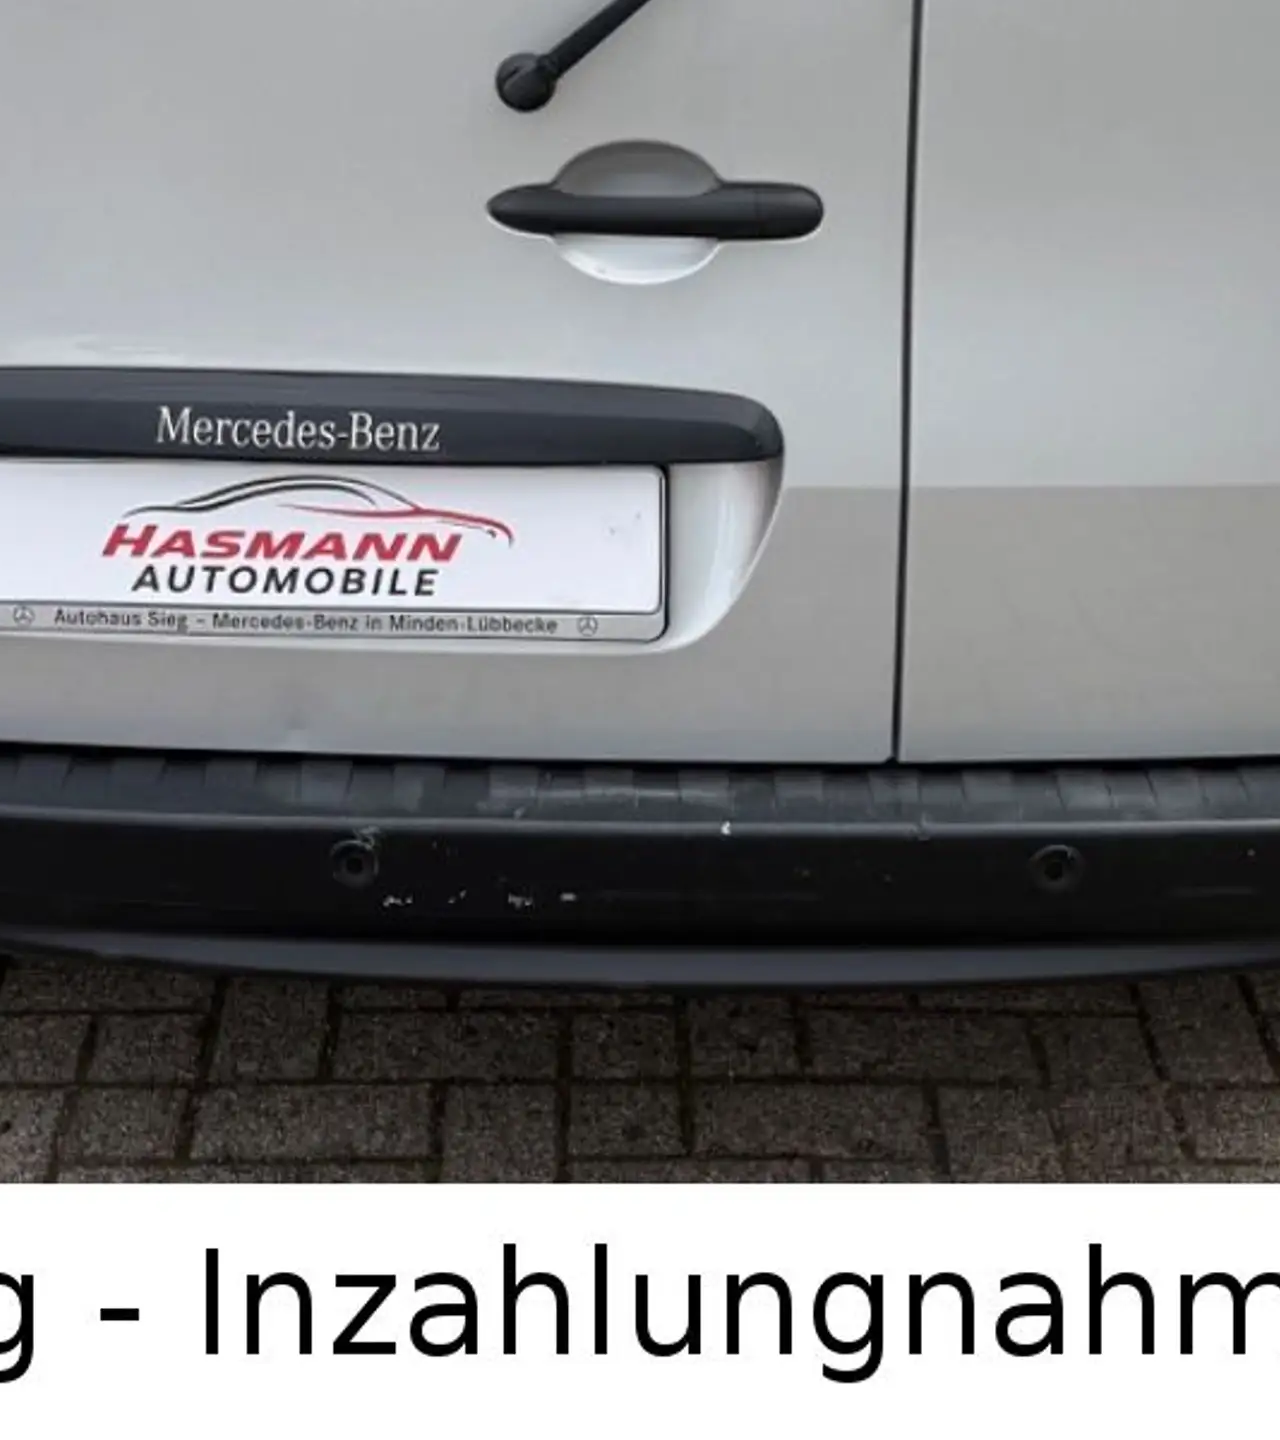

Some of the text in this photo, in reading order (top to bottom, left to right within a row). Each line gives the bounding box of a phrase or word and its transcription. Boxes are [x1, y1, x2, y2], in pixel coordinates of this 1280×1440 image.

[156, 405, 441, 451] Mercedes-Benz
[102, 524, 462, 563] HASMANN
[131, 564, 439, 597] AUTOMOBILE
[54, 609, 142, 627] Autohaus
[212, 612, 358, 632] Mercedes-Benz
[366, 614, 383, 631] in
[389, 614, 559, 634] Minden-Lübbecke
